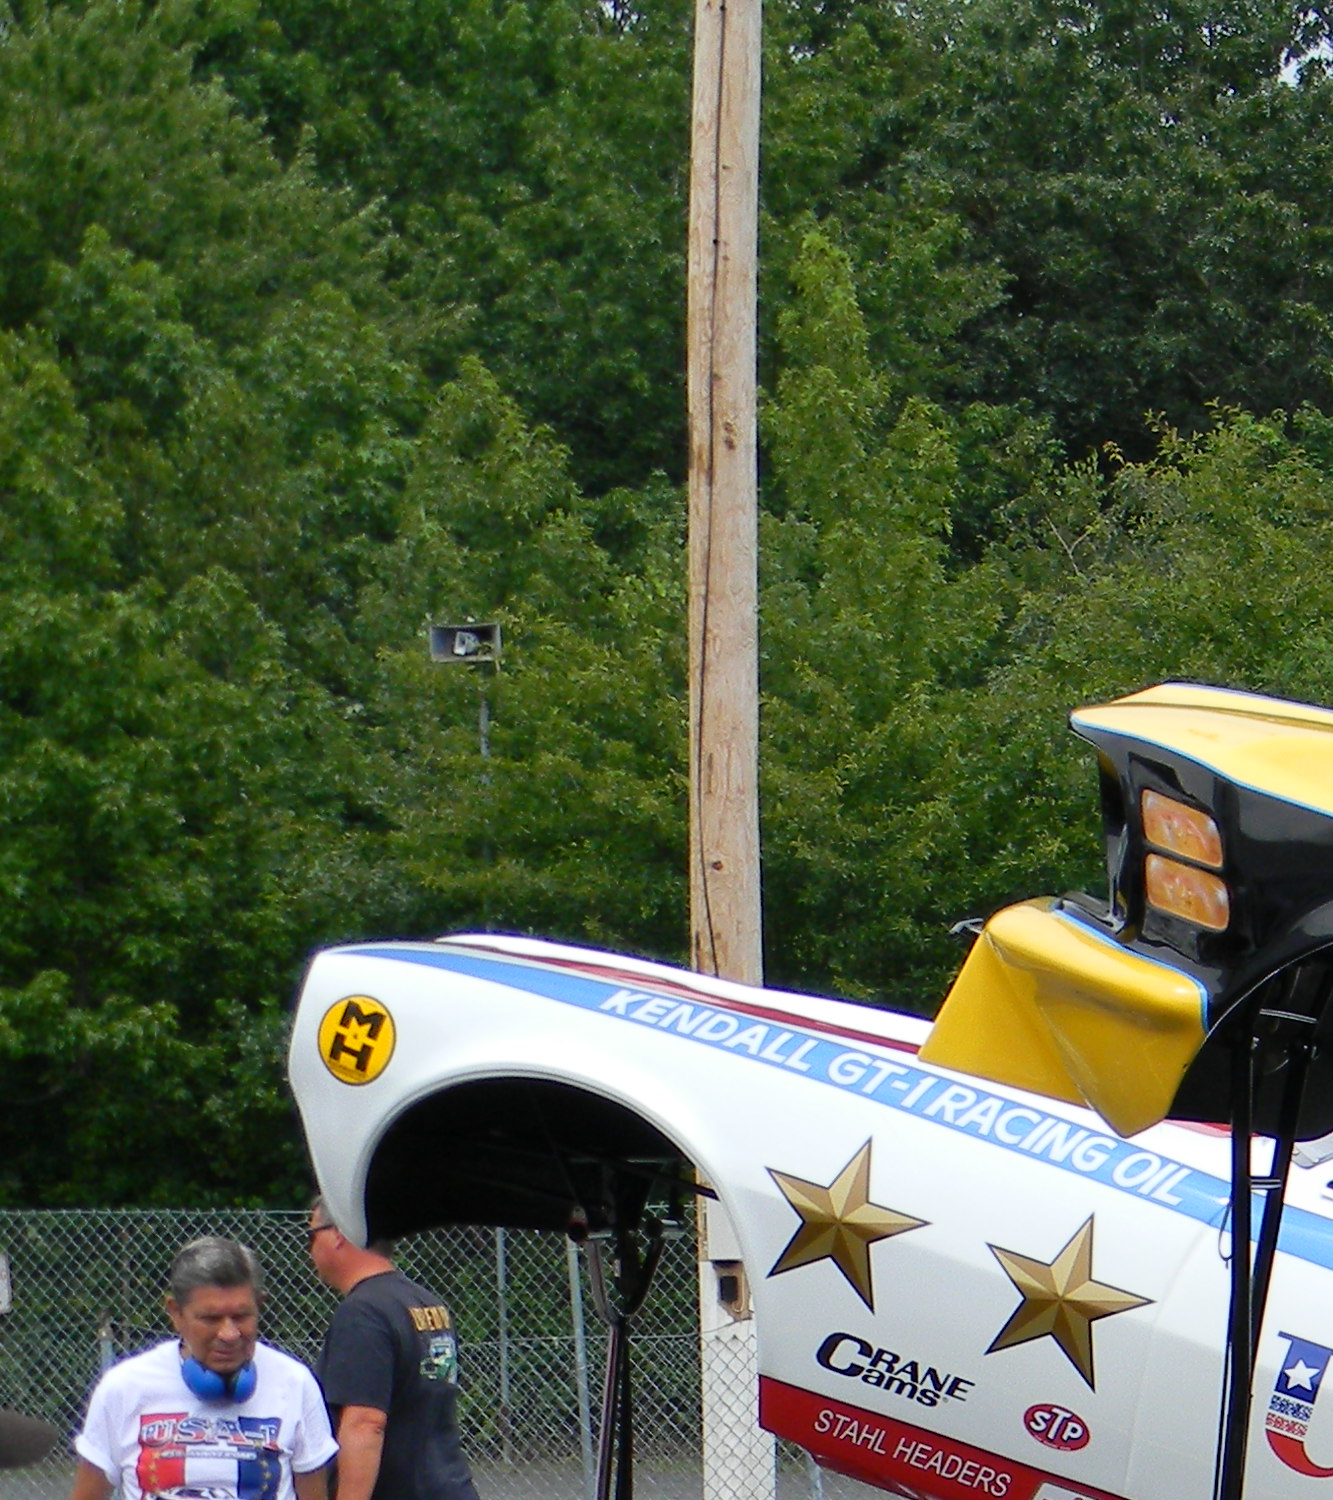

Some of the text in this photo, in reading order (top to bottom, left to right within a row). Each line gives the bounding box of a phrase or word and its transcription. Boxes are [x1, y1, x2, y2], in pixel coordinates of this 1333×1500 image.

[601, 988, 1196, 1206] KENDALL GT-1 RACING OIL
[816, 1331, 976, 1402] CRANE
[813, 1409, 1012, 1497] STAHL HEADERS
[1029, 1407, 1084, 1442] STP
